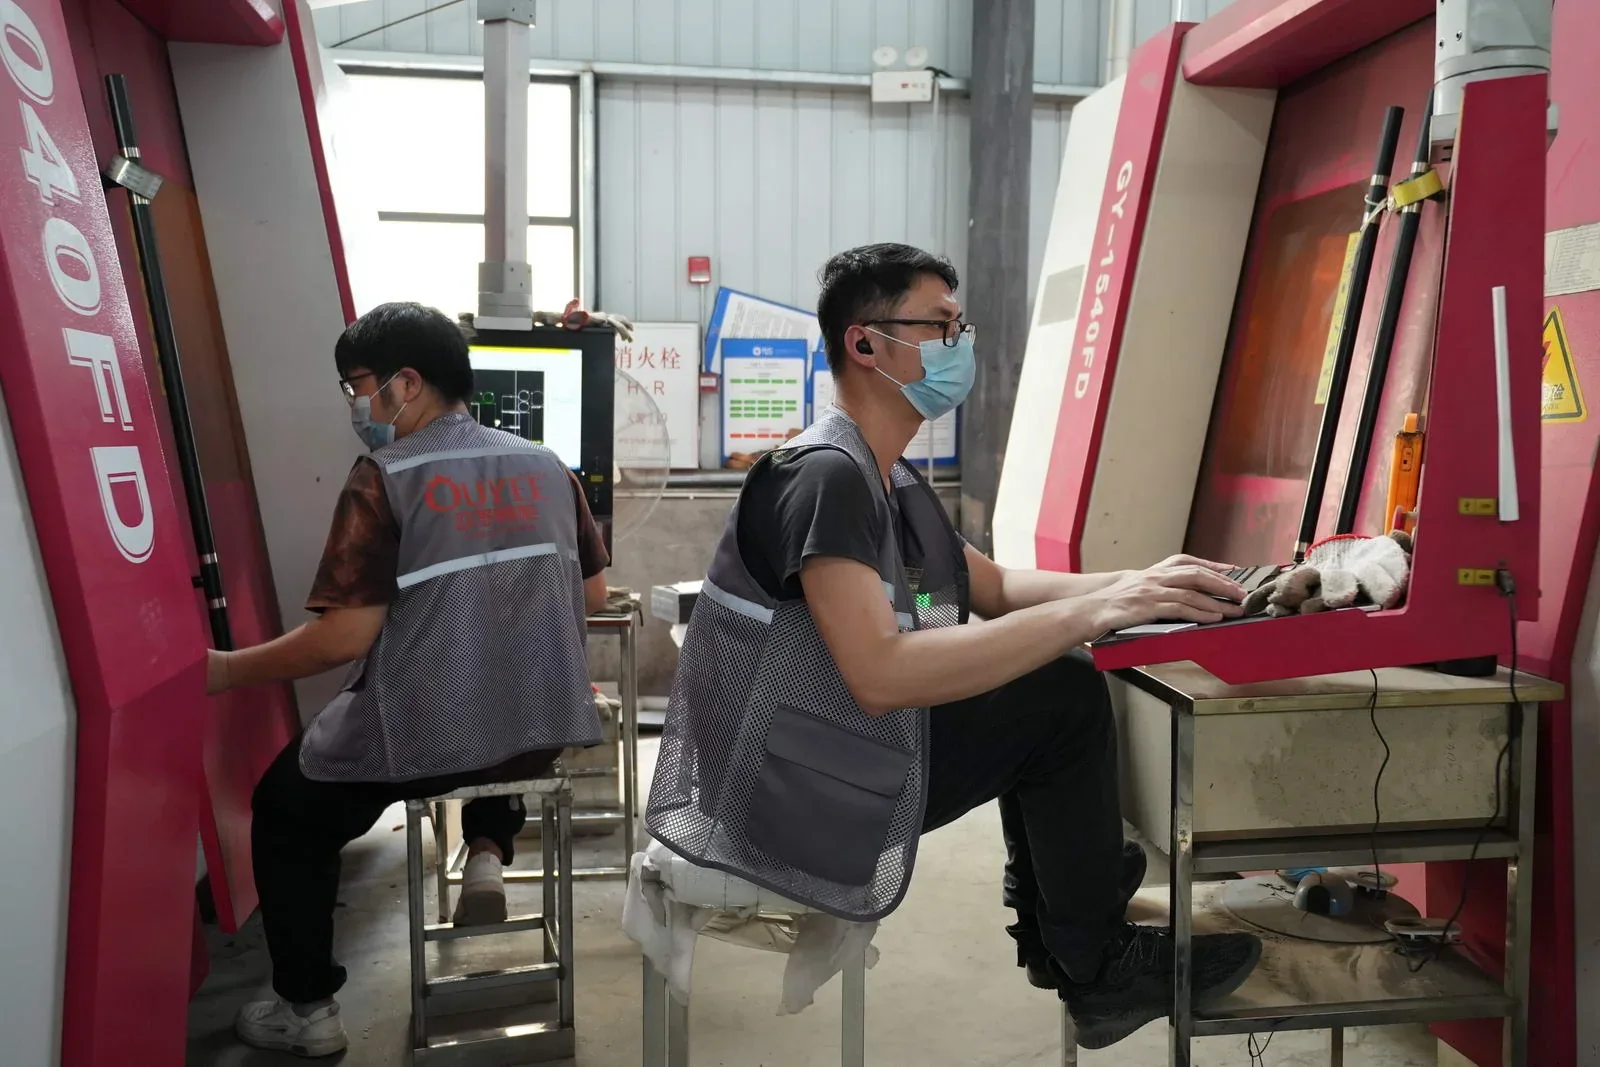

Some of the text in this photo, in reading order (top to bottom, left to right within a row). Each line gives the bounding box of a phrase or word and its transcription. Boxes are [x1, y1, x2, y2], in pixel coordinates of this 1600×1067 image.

[1074, 160, 1133, 399] GY-1540FD
[616, 346, 681, 369] 消火栓
